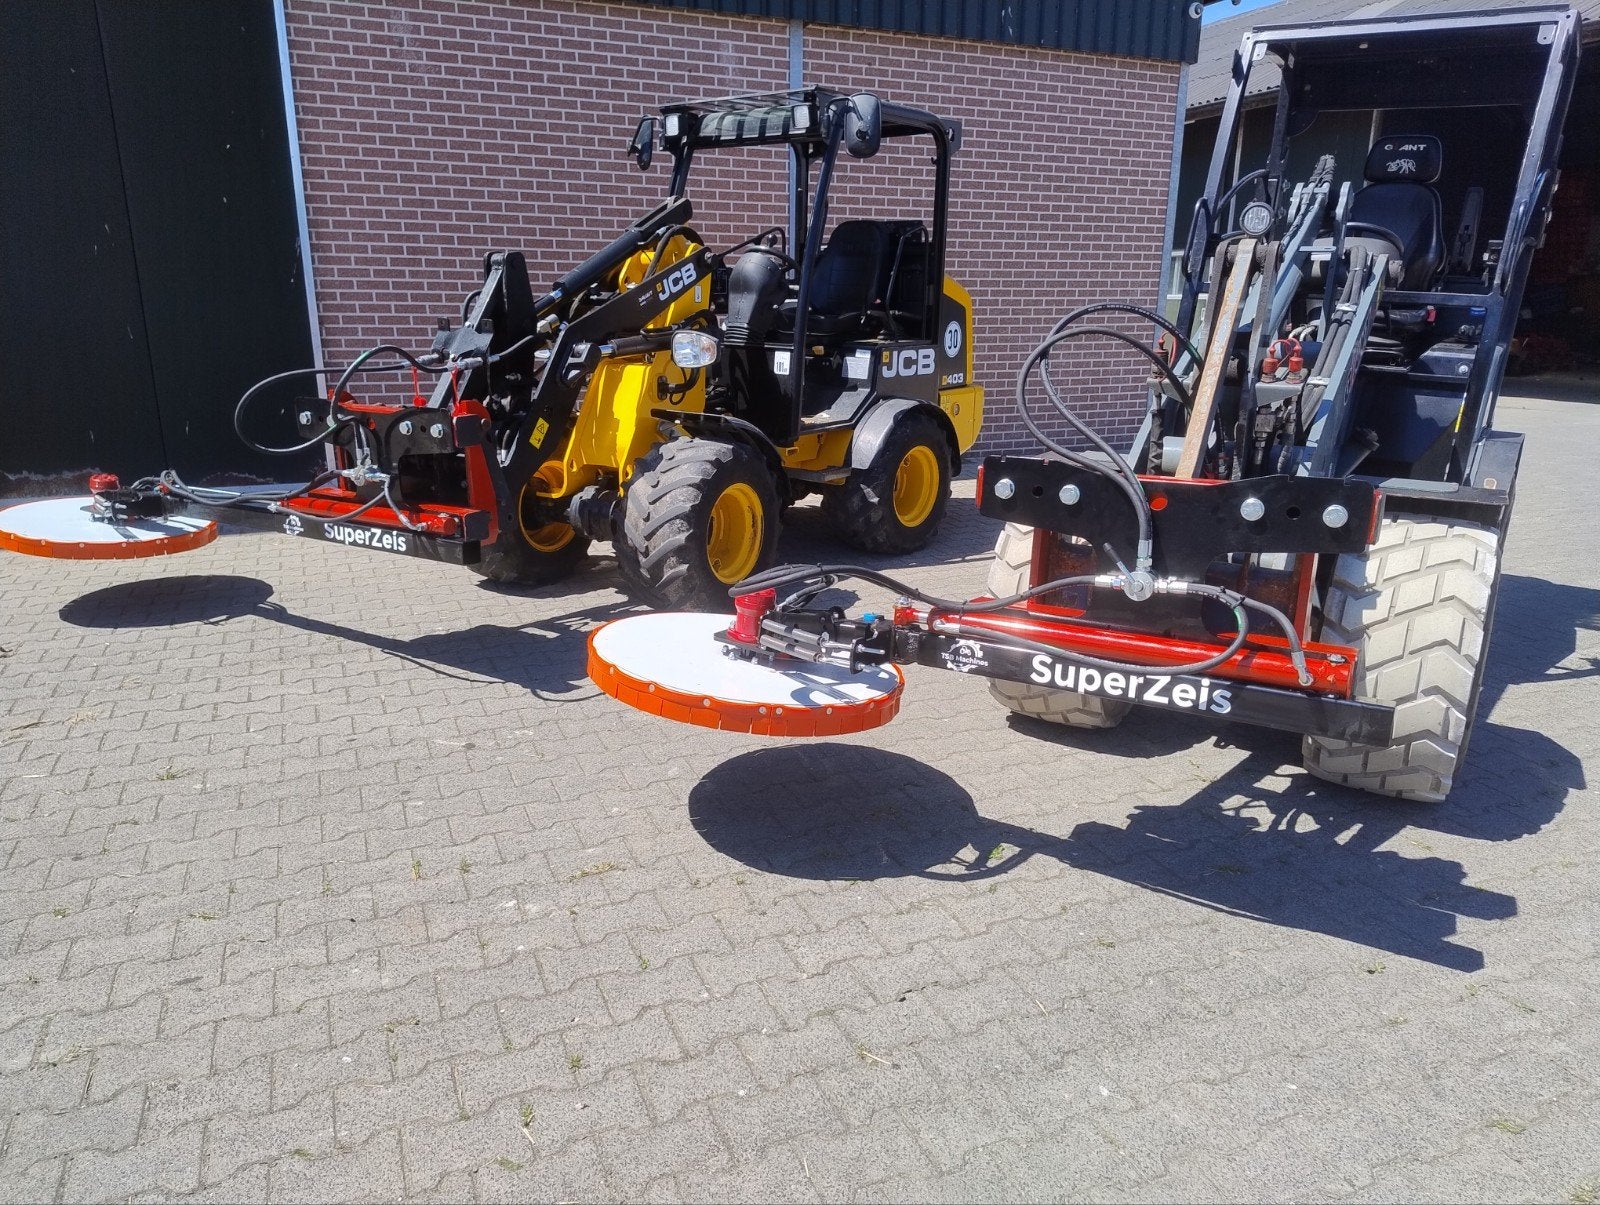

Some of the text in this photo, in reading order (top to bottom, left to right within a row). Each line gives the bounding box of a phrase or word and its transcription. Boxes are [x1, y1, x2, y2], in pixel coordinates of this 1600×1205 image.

[657, 262, 697, 301] JCB
[948, 328, 959, 350] 30
[882, 348, 936, 378] JCB
[941, 373, 964, 386] D403
[324, 523, 407, 552] SuperZeis
[1030, 654, 1232, 714] SuperZeis
